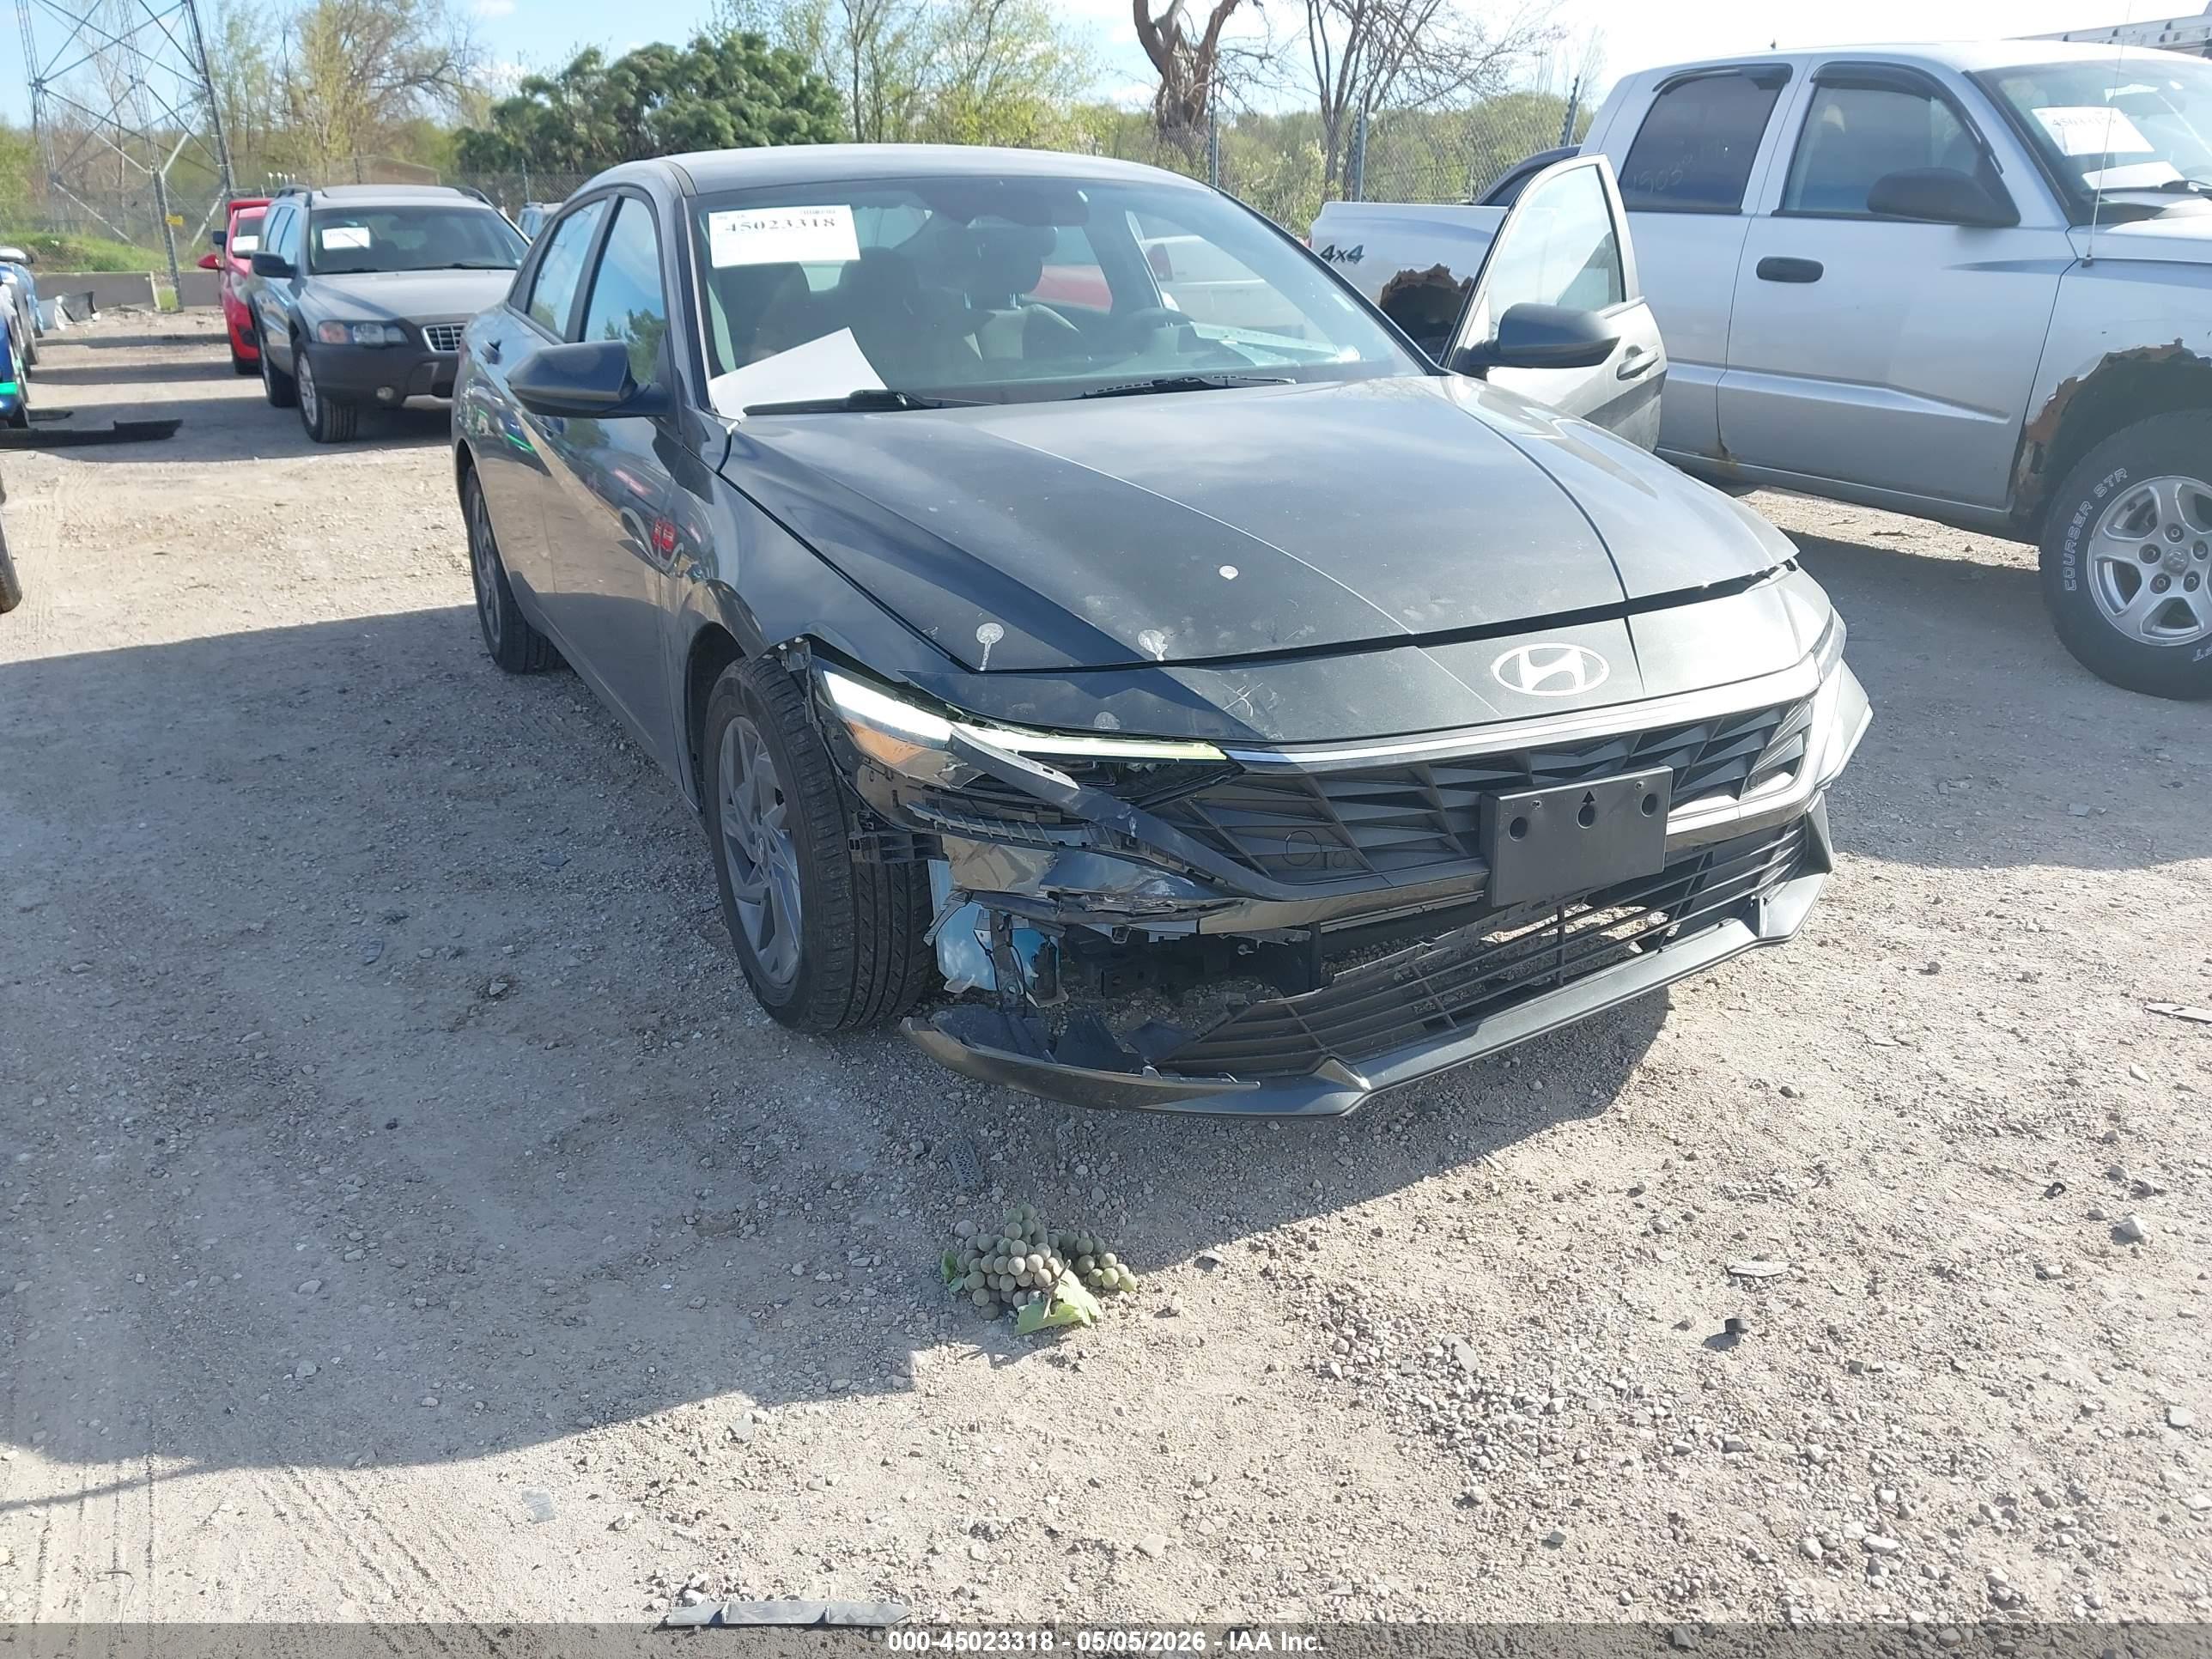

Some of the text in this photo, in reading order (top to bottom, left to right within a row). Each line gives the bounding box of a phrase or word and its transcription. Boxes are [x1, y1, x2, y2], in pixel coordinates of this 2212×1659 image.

[725, 217, 836, 233] 45023318
[1319, 244, 1365, 264] 4x4
[2063, 468, 2128, 592] COURSER STR
